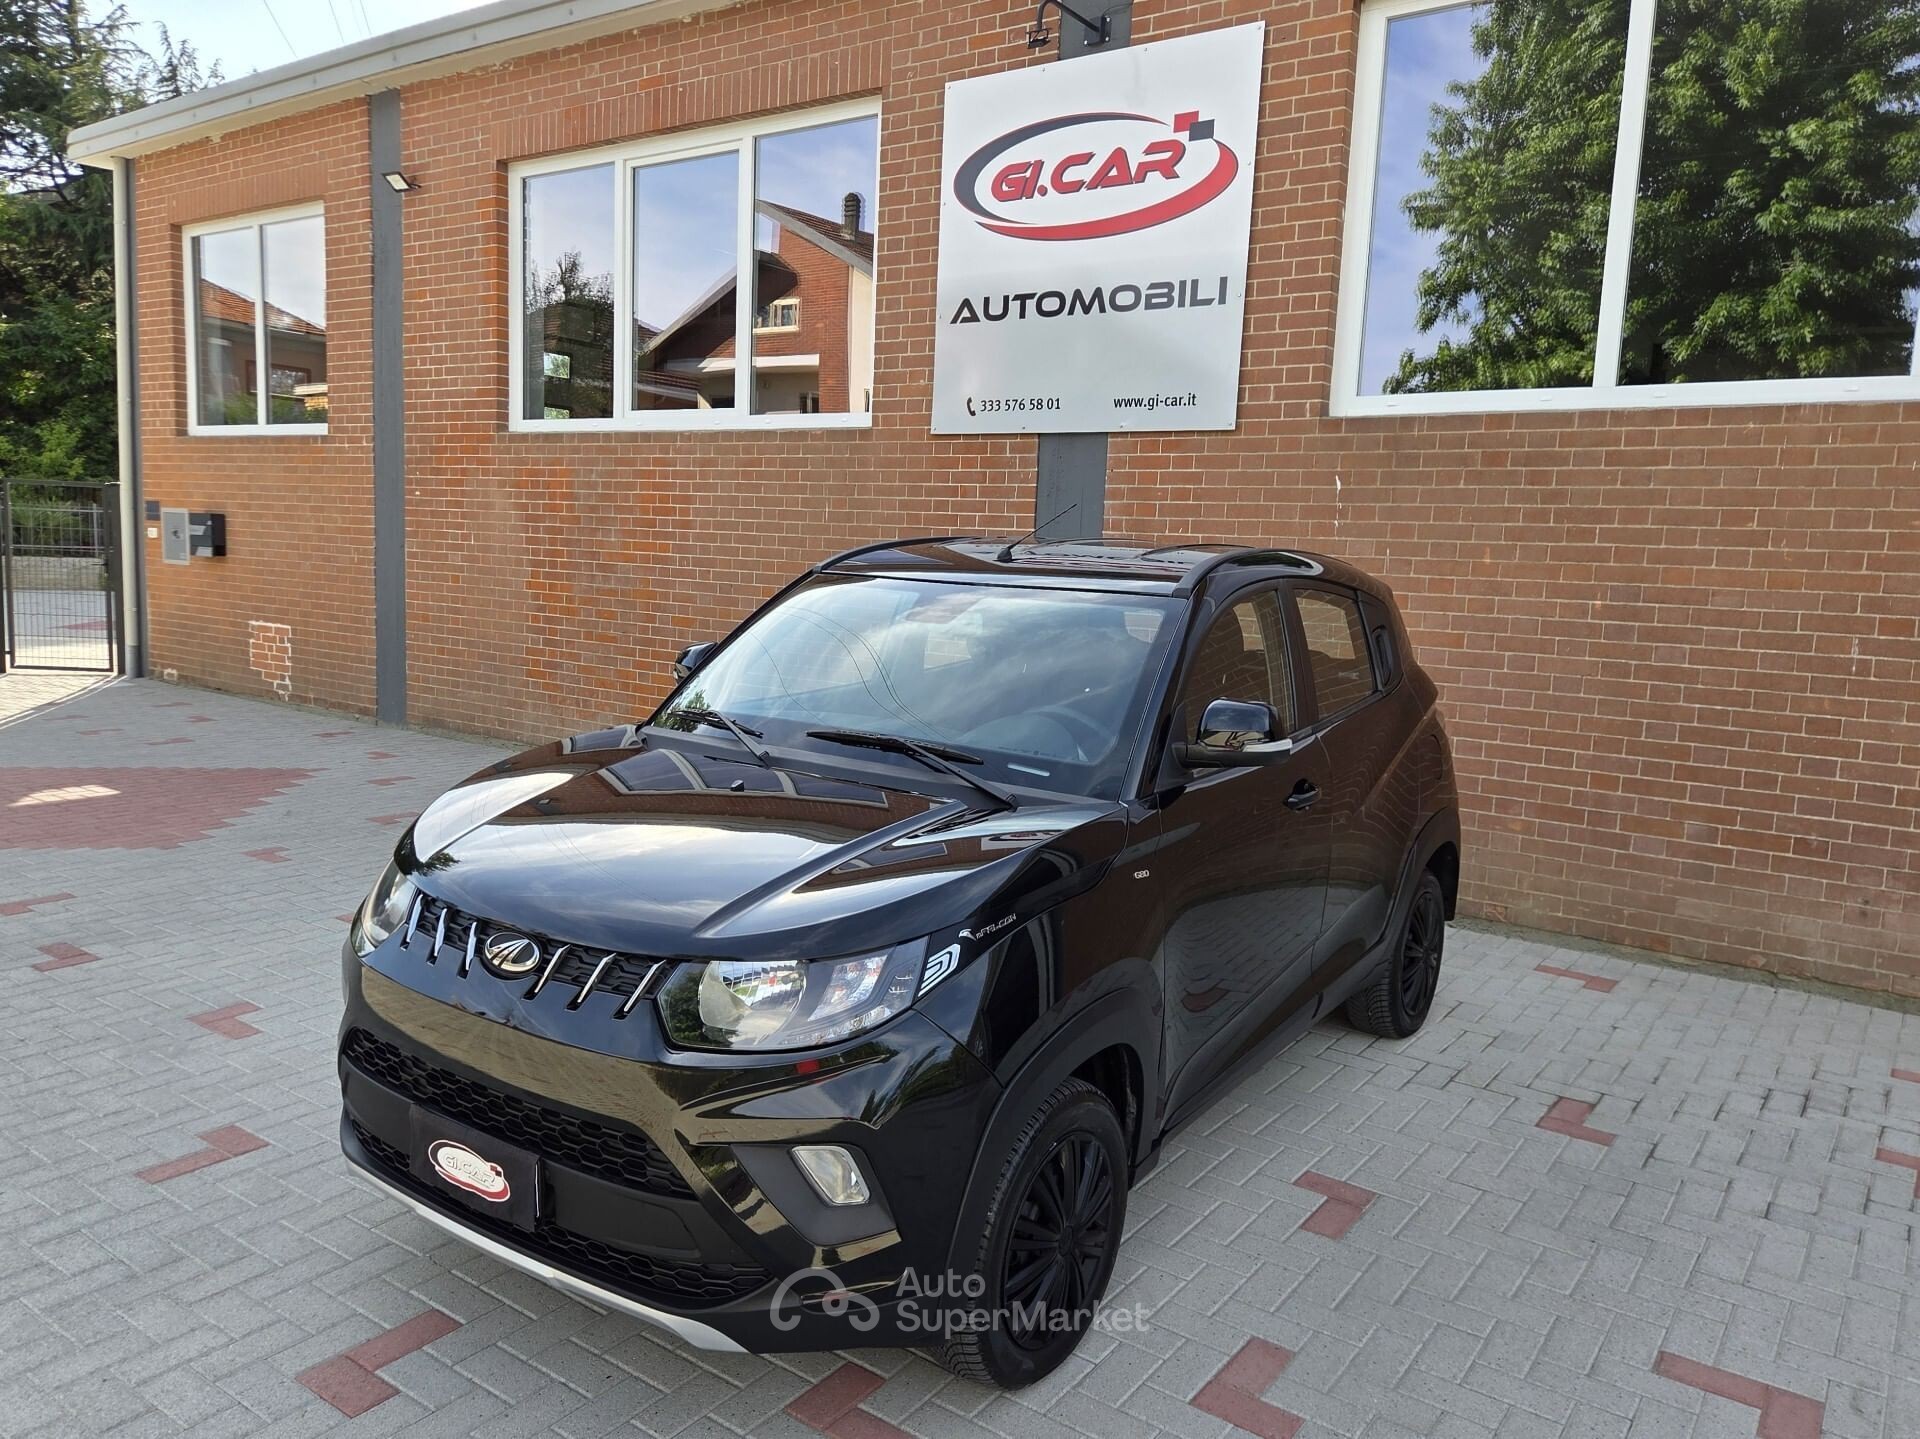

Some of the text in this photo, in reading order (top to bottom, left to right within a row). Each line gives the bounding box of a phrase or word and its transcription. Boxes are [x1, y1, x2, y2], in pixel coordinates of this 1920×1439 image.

[991, 139, 1185, 202] GI.CAR
[950, 276, 1228, 324] AUTOMOBILI
[980, 397, 1061, 412] 333 576 58 01
[1113, 392, 1197, 410] www.gi-car.it
